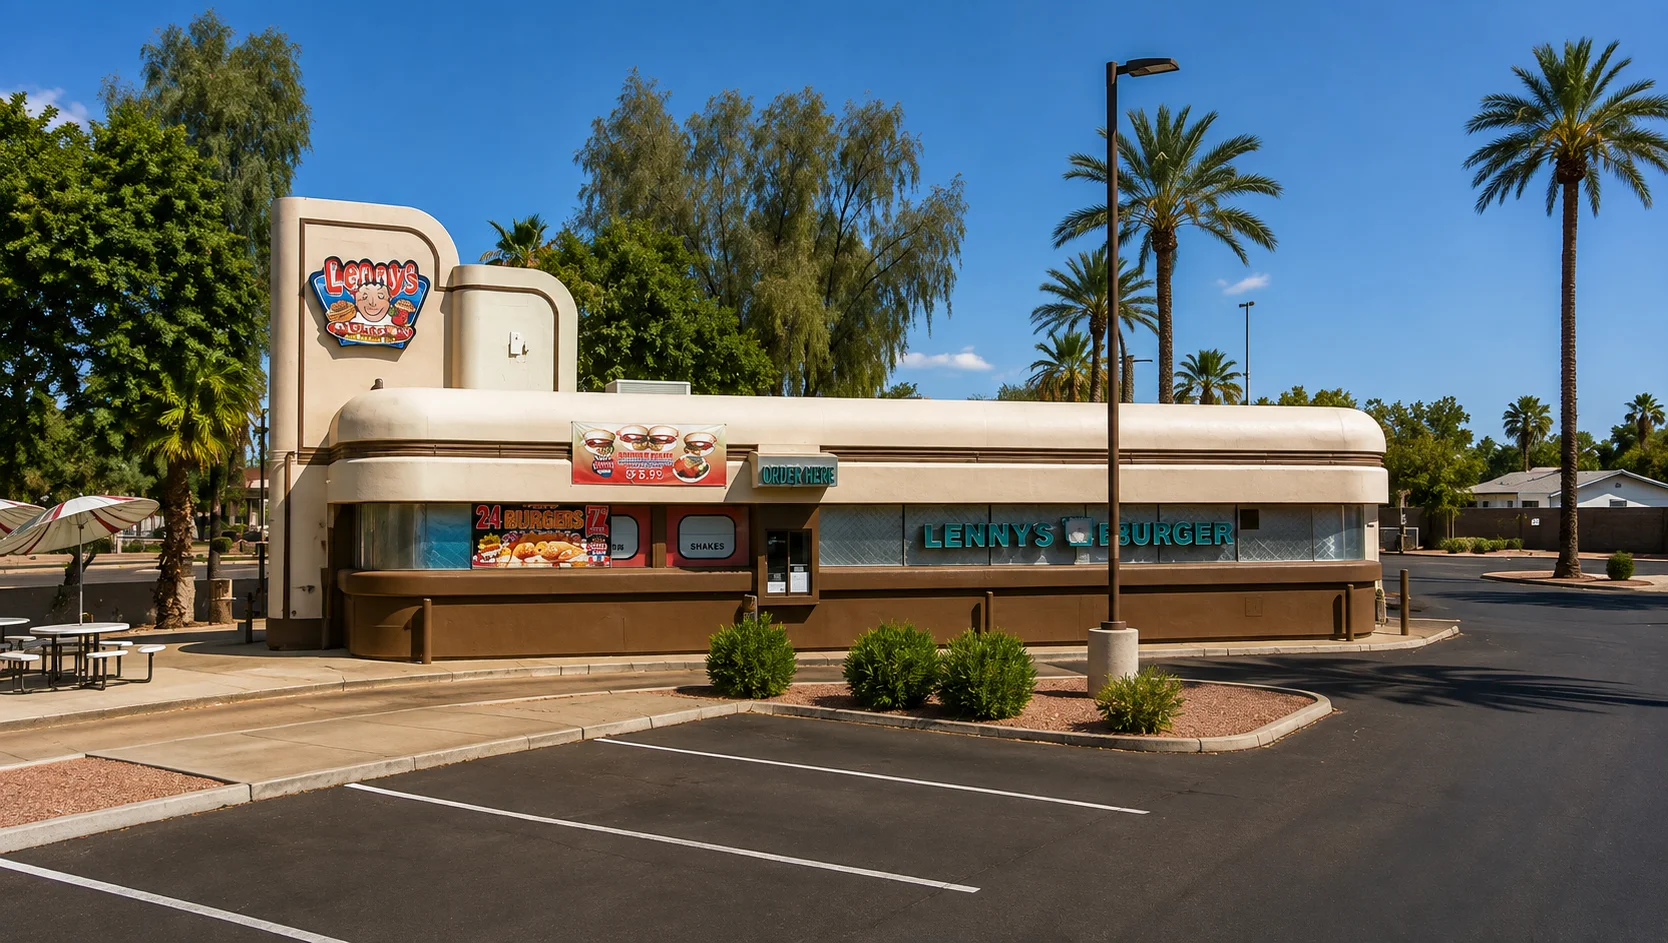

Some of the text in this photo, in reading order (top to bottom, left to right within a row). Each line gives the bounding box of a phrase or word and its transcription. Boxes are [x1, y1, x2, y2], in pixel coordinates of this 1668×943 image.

[763, 465, 835, 484] ORDER HERE
[475, 505, 584, 529] 24 BURGERS
[923, 522, 1054, 548] LENNYS
[690, 542, 725, 551] SHAKES
